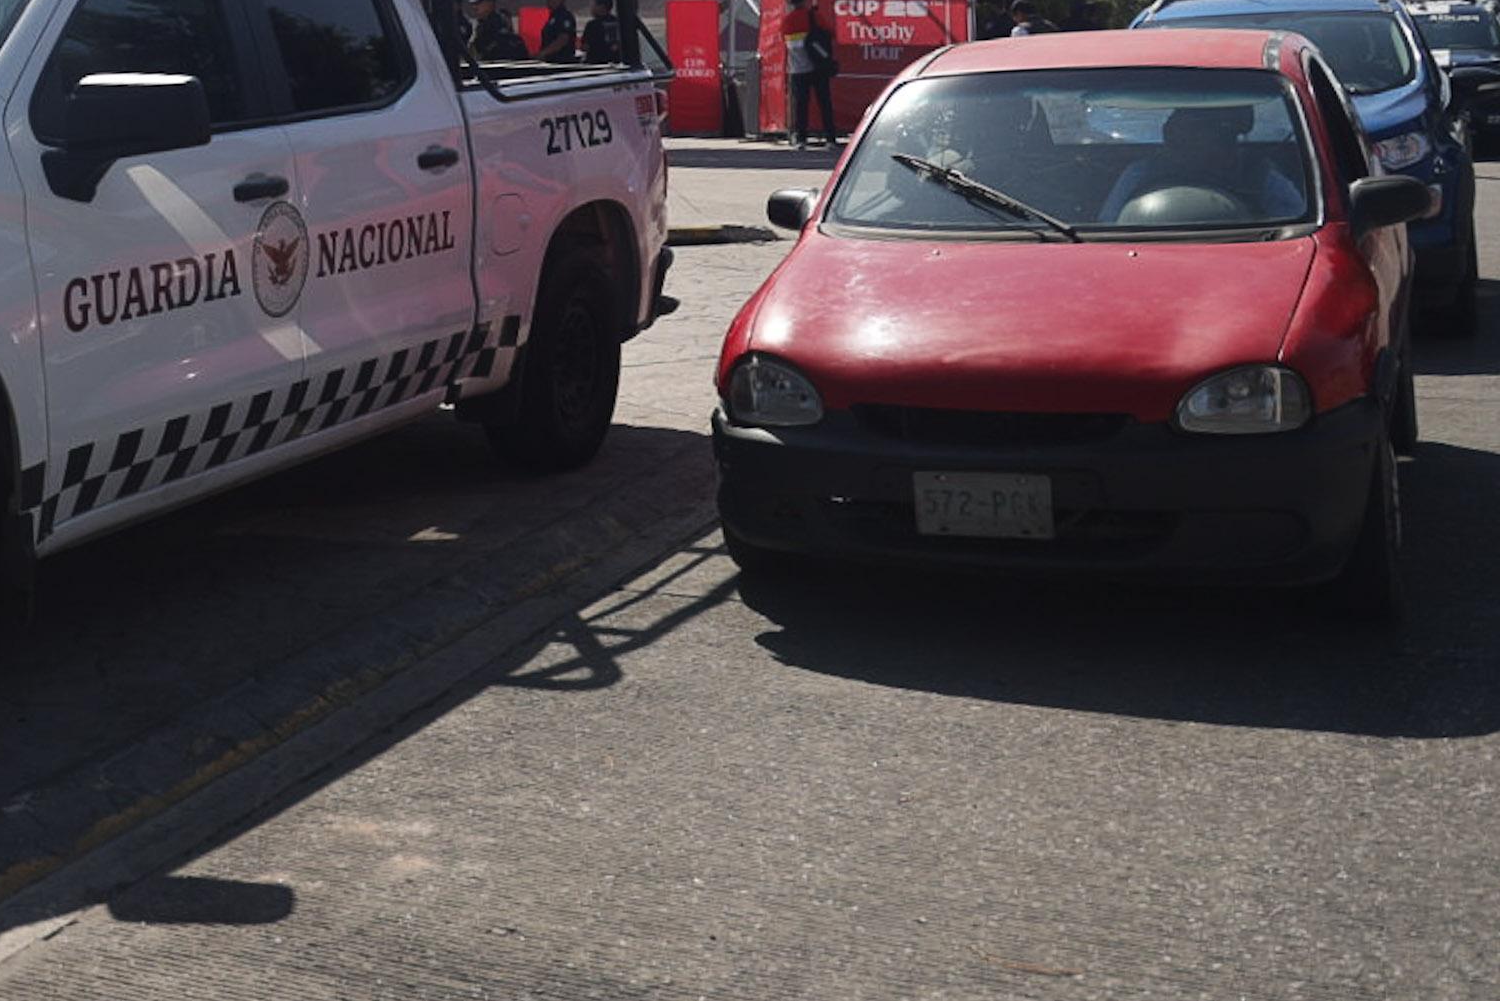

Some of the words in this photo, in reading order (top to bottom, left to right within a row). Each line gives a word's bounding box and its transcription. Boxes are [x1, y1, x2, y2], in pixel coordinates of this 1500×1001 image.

[834, 0, 880, 17] CUP
[847, 21, 915, 44] Trophy
[859, 43, 904, 61] Tour
[540, 109, 613, 156] 27129
[64, 248, 241, 333] GUARDIA
[317, 210, 455, 278] NACIONAL
